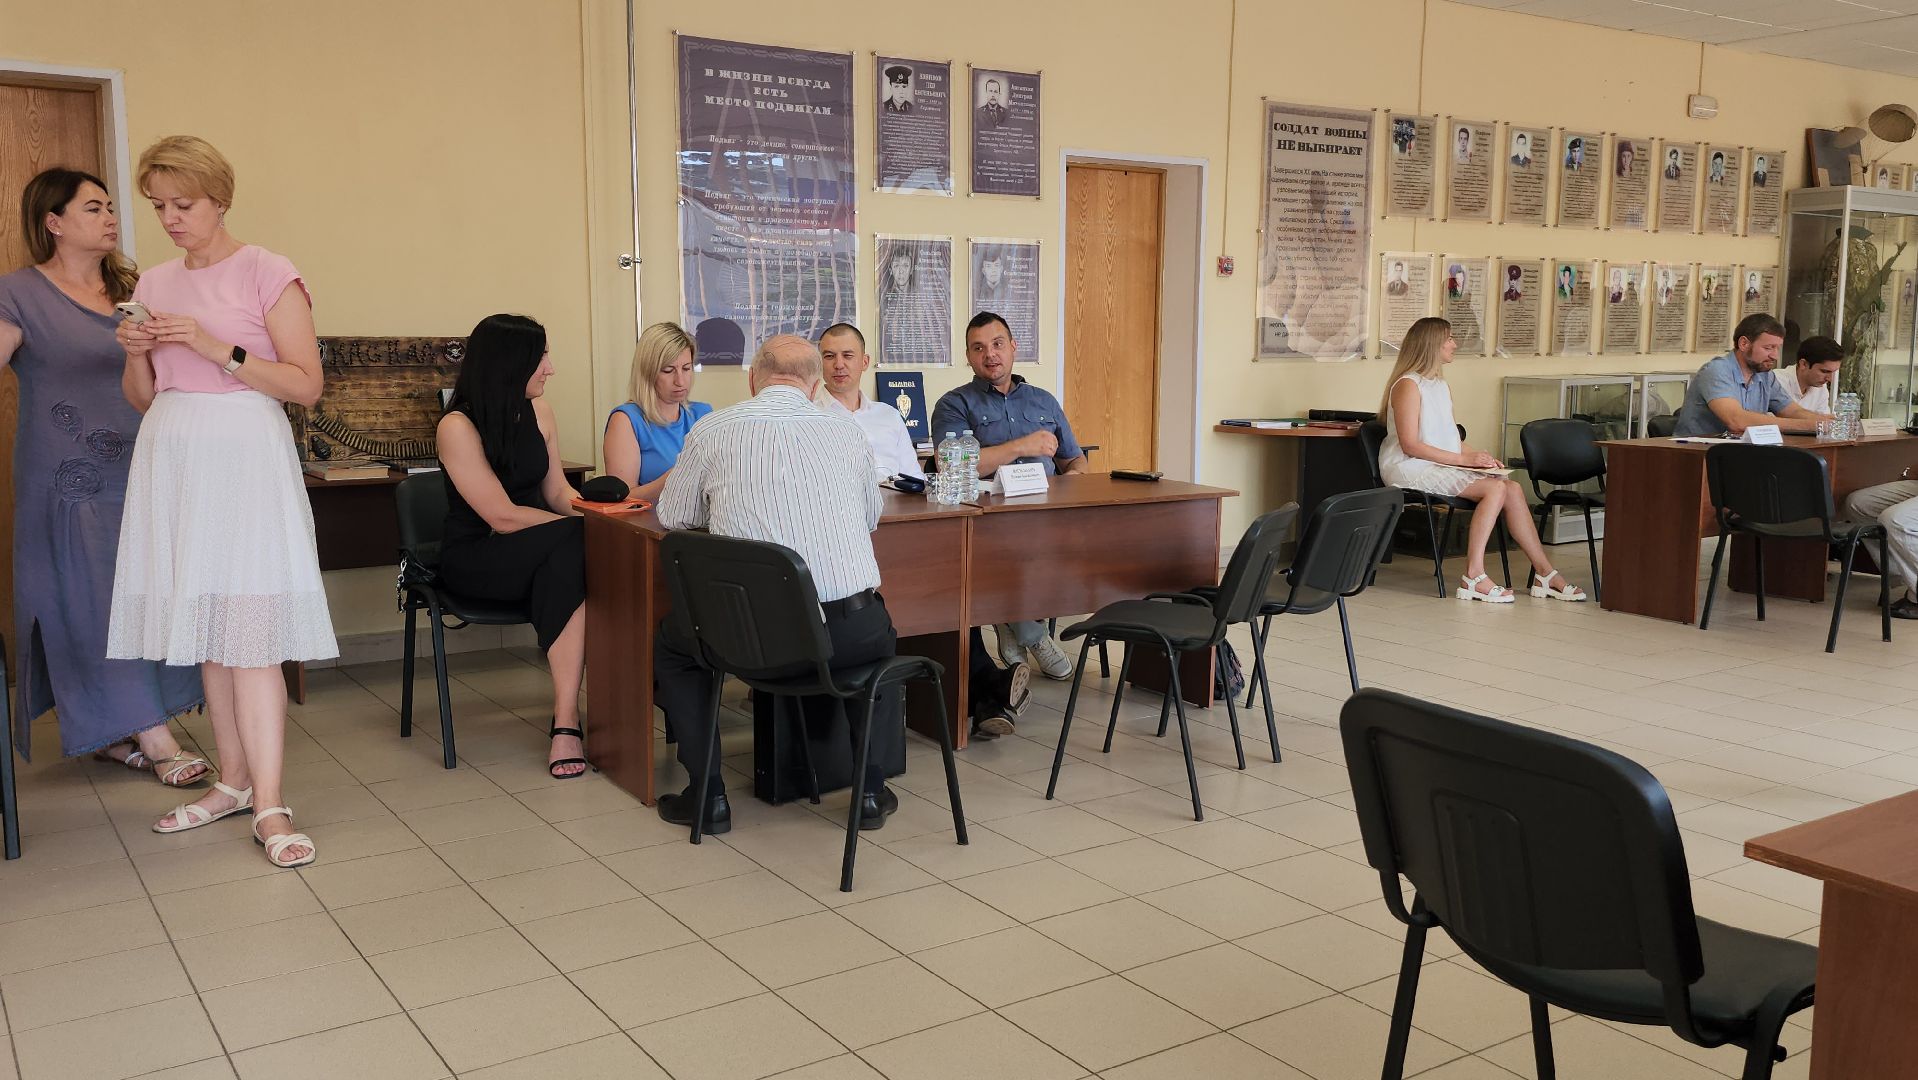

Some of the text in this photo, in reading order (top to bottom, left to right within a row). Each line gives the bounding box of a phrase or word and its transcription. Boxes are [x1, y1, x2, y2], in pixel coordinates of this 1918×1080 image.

[704, 68, 832, 90] В ЖИЗНИ ВСЕГДА
[753, 86, 789, 98] ЕСТЬ
[704, 95, 751, 108] МЕСТО
[1273, 122, 1368, 140] СОЛДАТ ВОЙНЫ
[709, 134, 737, 144] Подвиг
[1277, 139, 1363, 156] НЕ ВЫБИРАЕТ
[704, 190, 732, 199] Подвиг
[713, 203, 755, 212] требующий
[803, 207, 829, 215] особого
